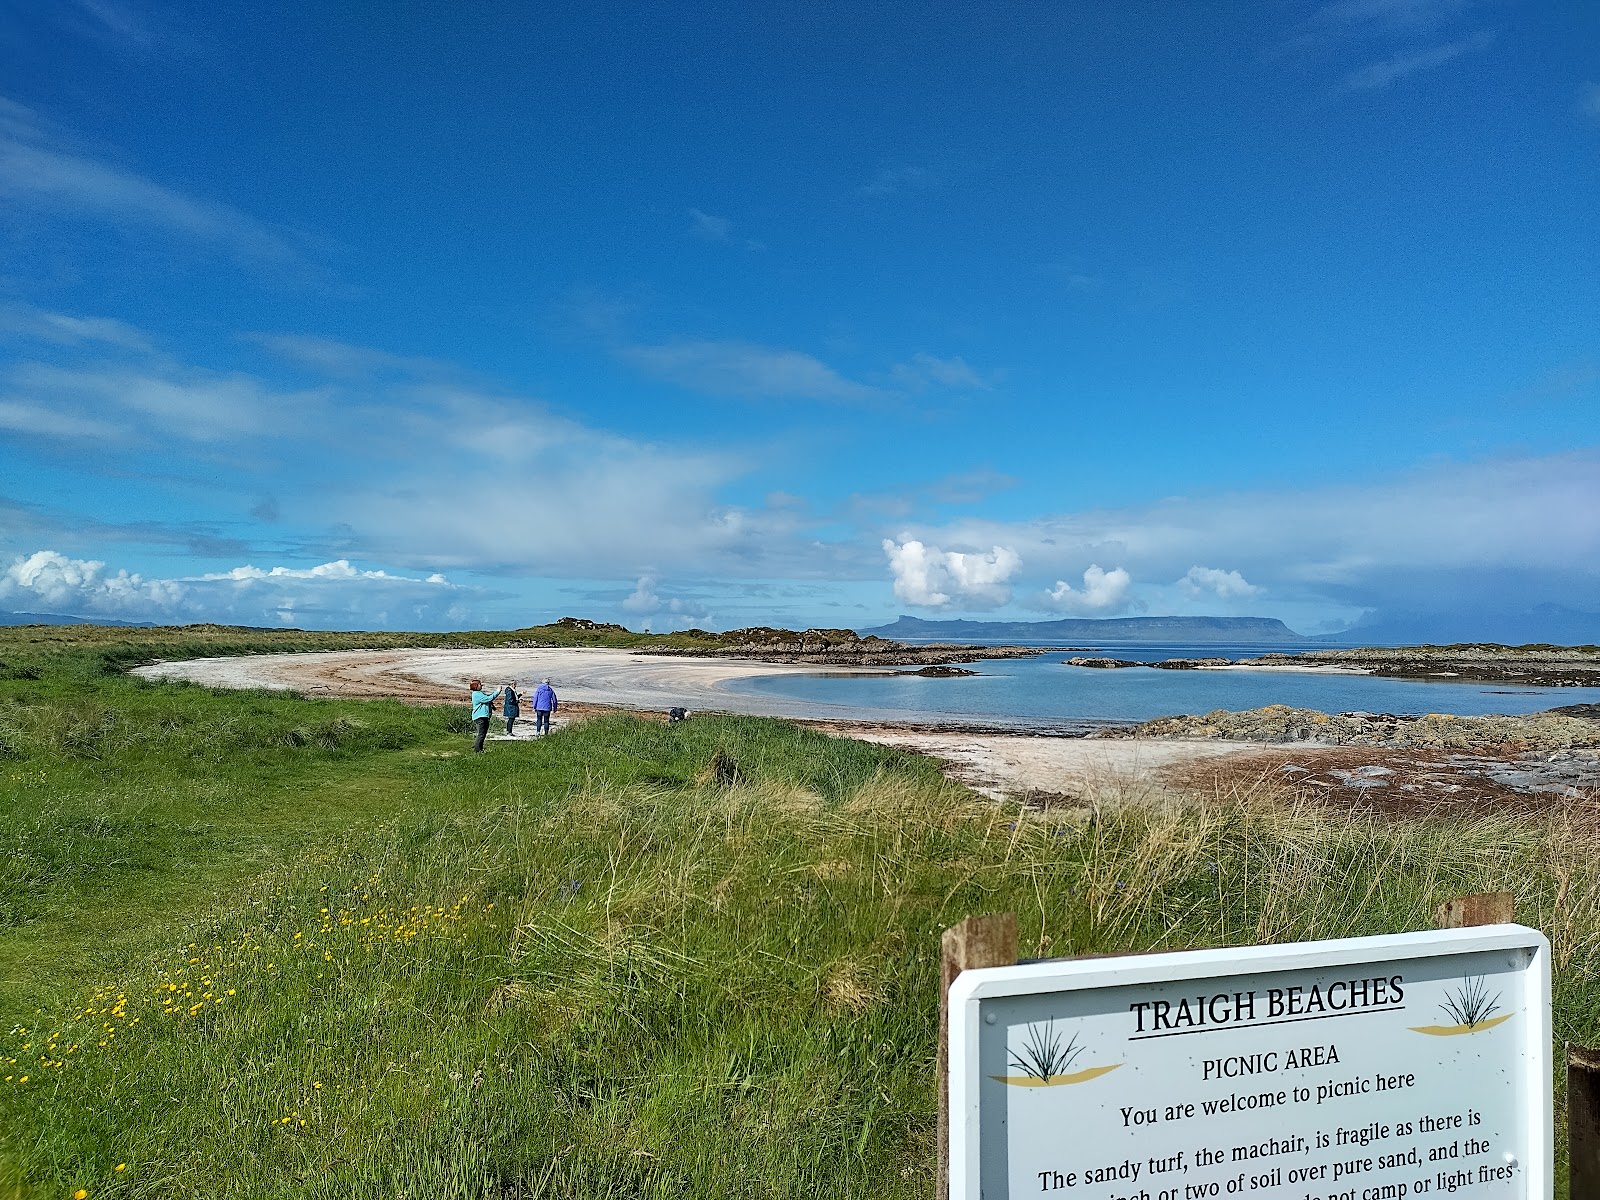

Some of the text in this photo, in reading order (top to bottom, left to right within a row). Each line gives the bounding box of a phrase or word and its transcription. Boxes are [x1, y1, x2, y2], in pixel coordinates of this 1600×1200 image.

[1130, 975, 1404, 1033] TRAIGH BEACHES
[1203, 1045, 1340, 1080] PICNIC AREA
[1120, 1074, 1414, 1126] You are welcome to picnic here
[1038, 1109, 1480, 1191] The sandy turf, the machair, is fragile as there is
[1159, 1189, 1178, 1200] or
[1185, 1183, 1219, 1200] two
[1227, 1174, 1245, 1193] of
[1251, 1168, 1281, 1189] soil
[1289, 1165, 1327, 1183] over
[1333, 1159, 1372, 1181] pure
[1379, 1147, 1422, 1169] sand,
[1429, 1141, 1458, 1161] and
[1464, 1138, 1489, 1155] the
[1363, 1184, 1407, 1200] camp
[1414, 1179, 1431, 1193] or
[1437, 1170, 1473, 1192] light
[1478, 1163, 1512, 1183] fires
